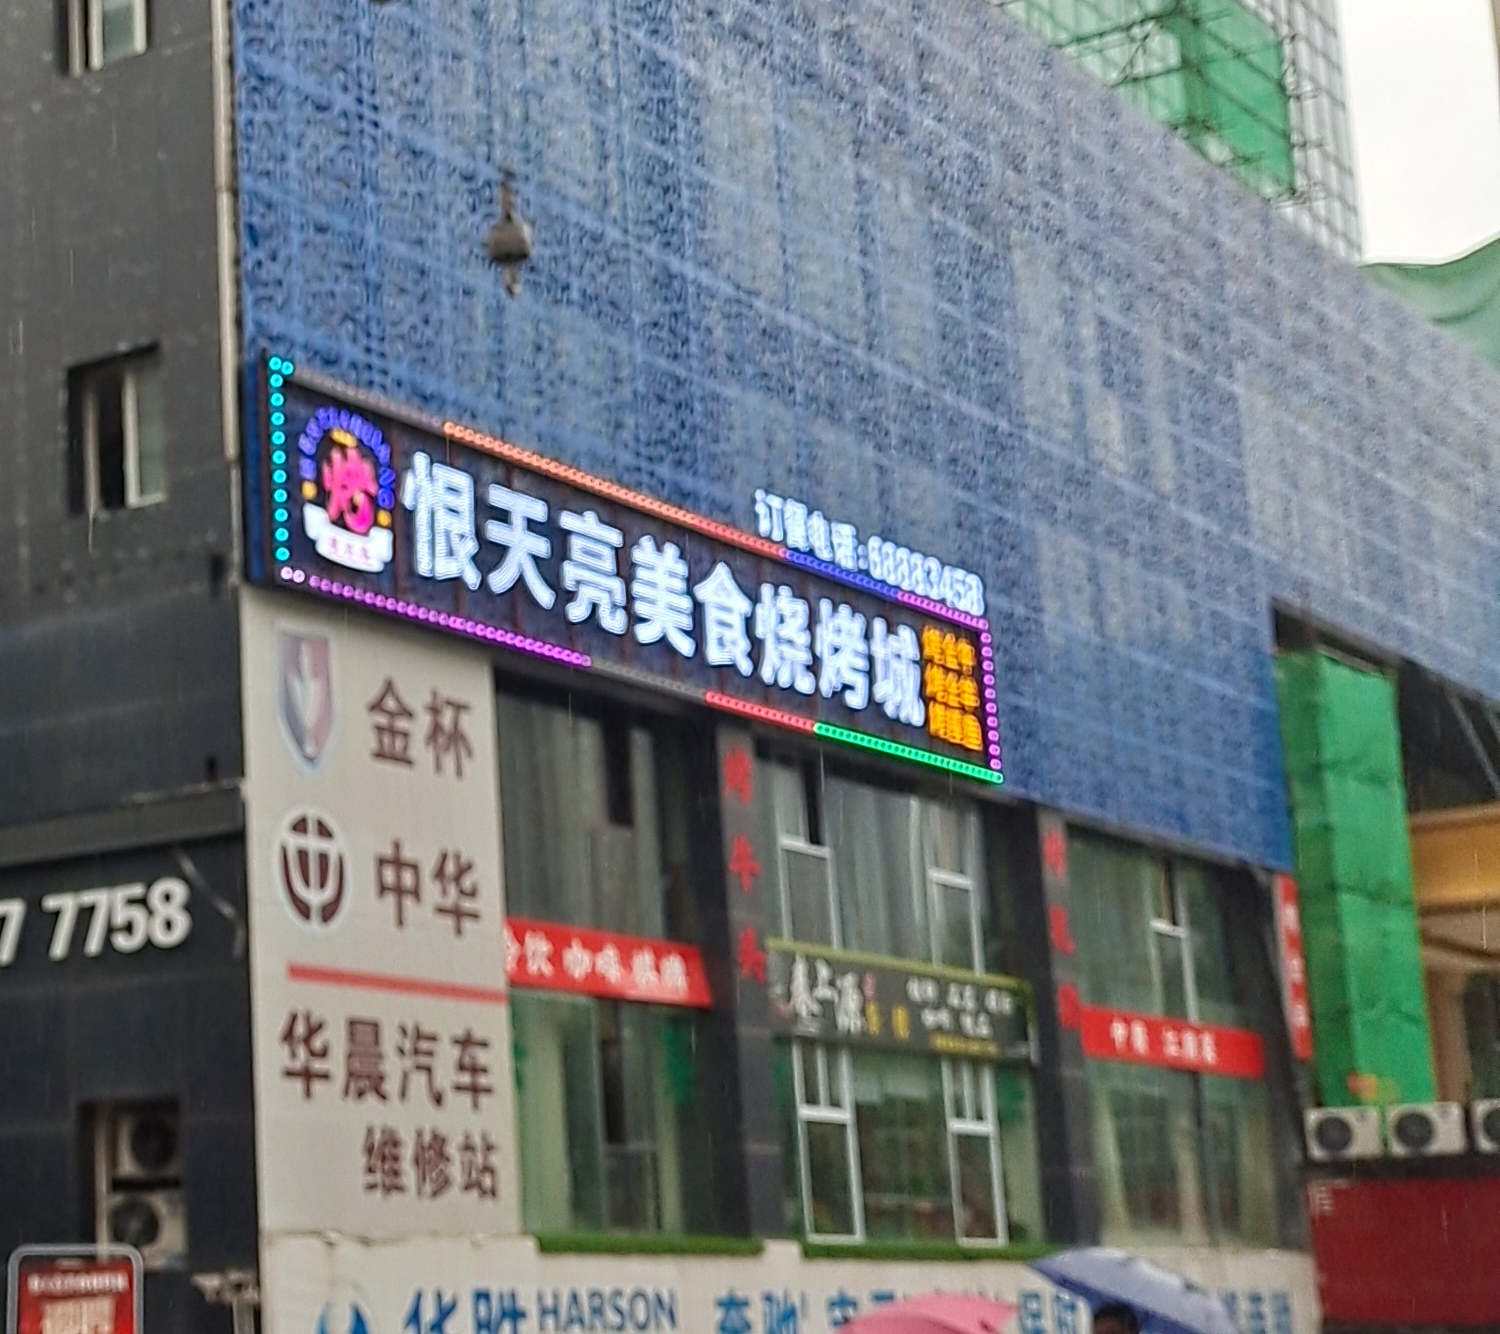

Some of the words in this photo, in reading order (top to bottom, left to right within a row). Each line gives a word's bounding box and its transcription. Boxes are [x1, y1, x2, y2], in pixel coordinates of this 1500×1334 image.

[402, 450, 926, 728] 恨天亮美食烧烤城
[367, 676, 474, 778] 金杯
[40, 875, 193, 963] 7758
[375, 839, 481, 936] 中华
[280, 1010, 494, 1112] 华晨汽车
[363, 1126, 499, 1200] 维修站
[536, 1289, 679, 1333] HARSON
